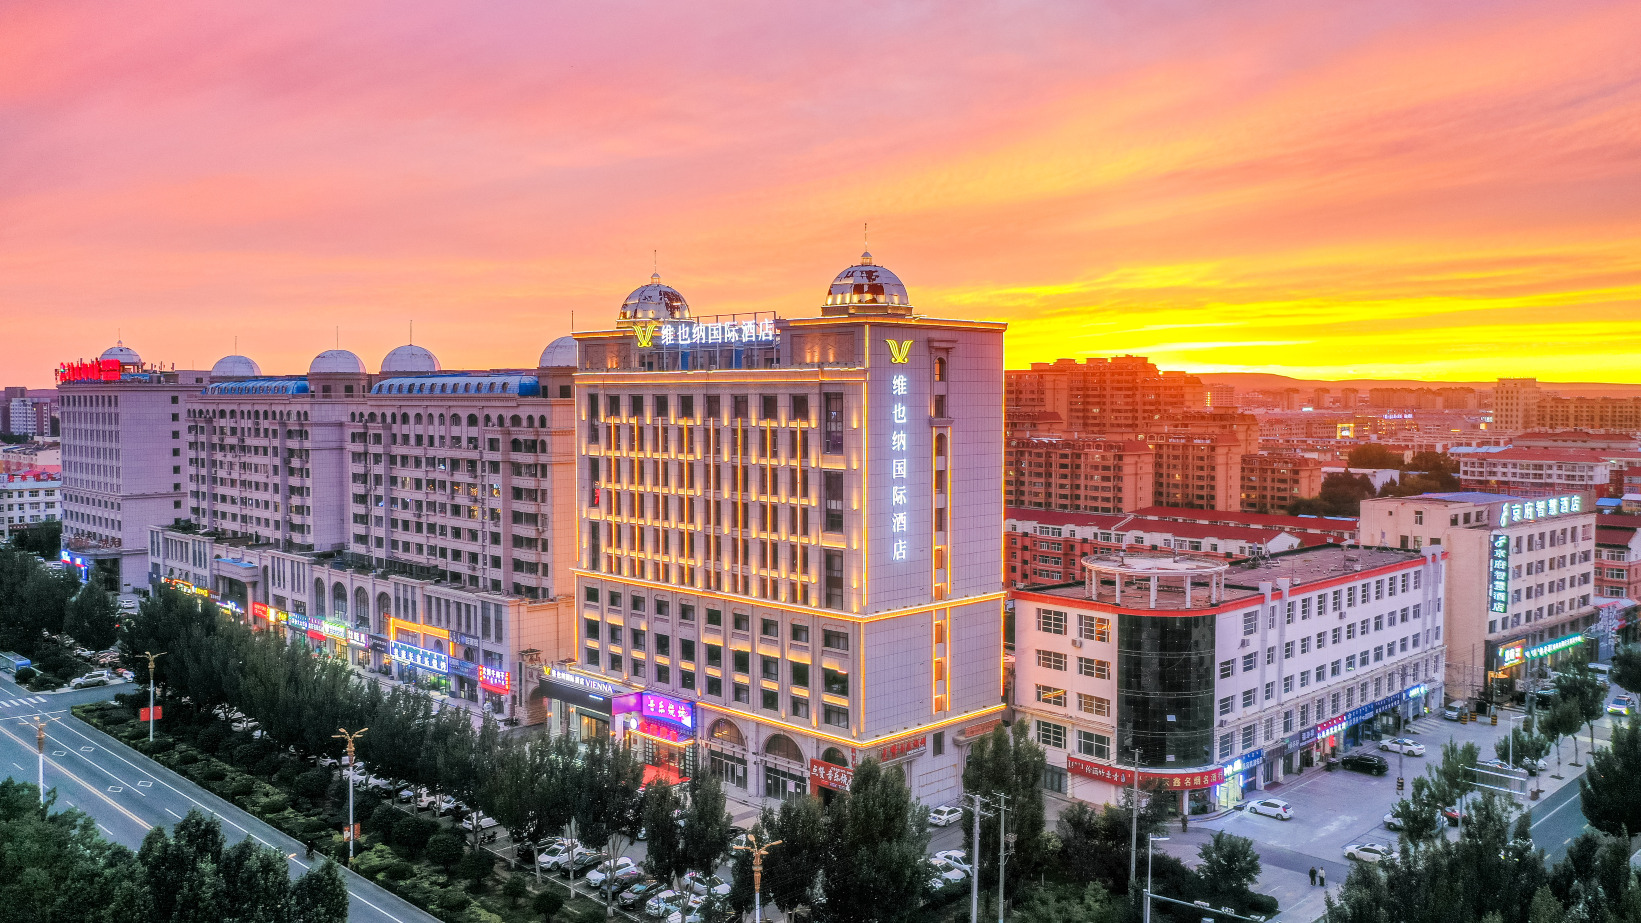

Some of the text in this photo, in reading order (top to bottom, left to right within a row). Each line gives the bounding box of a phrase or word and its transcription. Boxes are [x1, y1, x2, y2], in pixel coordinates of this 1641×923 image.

[661, 319, 774, 345] 维也纳国际酒店
[892, 375, 907, 561] 维也纳国际酒店
[1511, 495, 1582, 521] 京府智慧酒店
[1492, 549, 1507, 612] 京府智慧酒店
[585, 679, 613, 694] VIENNA
